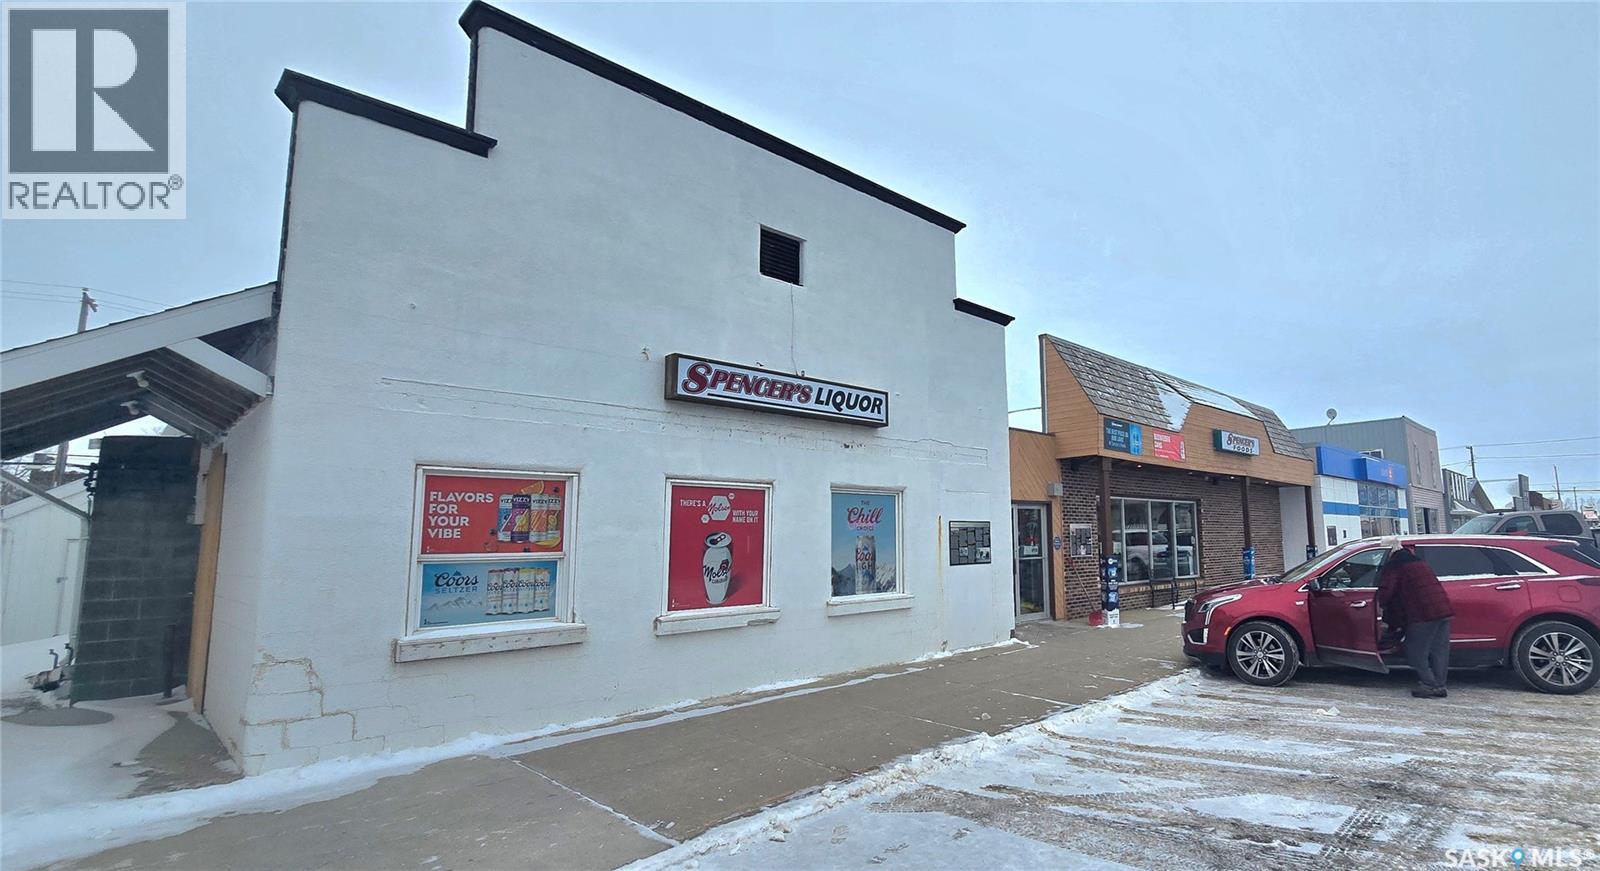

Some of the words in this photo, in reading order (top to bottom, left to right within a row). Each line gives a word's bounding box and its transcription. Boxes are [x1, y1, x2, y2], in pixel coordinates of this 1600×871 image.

[681, 362, 813, 404] SPENCER'S
[814, 387, 884, 414] LIQUOR
[1233, 444, 1253, 453] FOODS
[429, 491, 494, 503] FLAVORS
[680, 499, 701, 507] THERE'S
[428, 503, 459, 515] FOR
[428, 515, 470, 527] YOUR
[847, 507, 884, 524] Chill
[427, 528, 462, 539] VIBE
[434, 572, 480, 587] Coors
